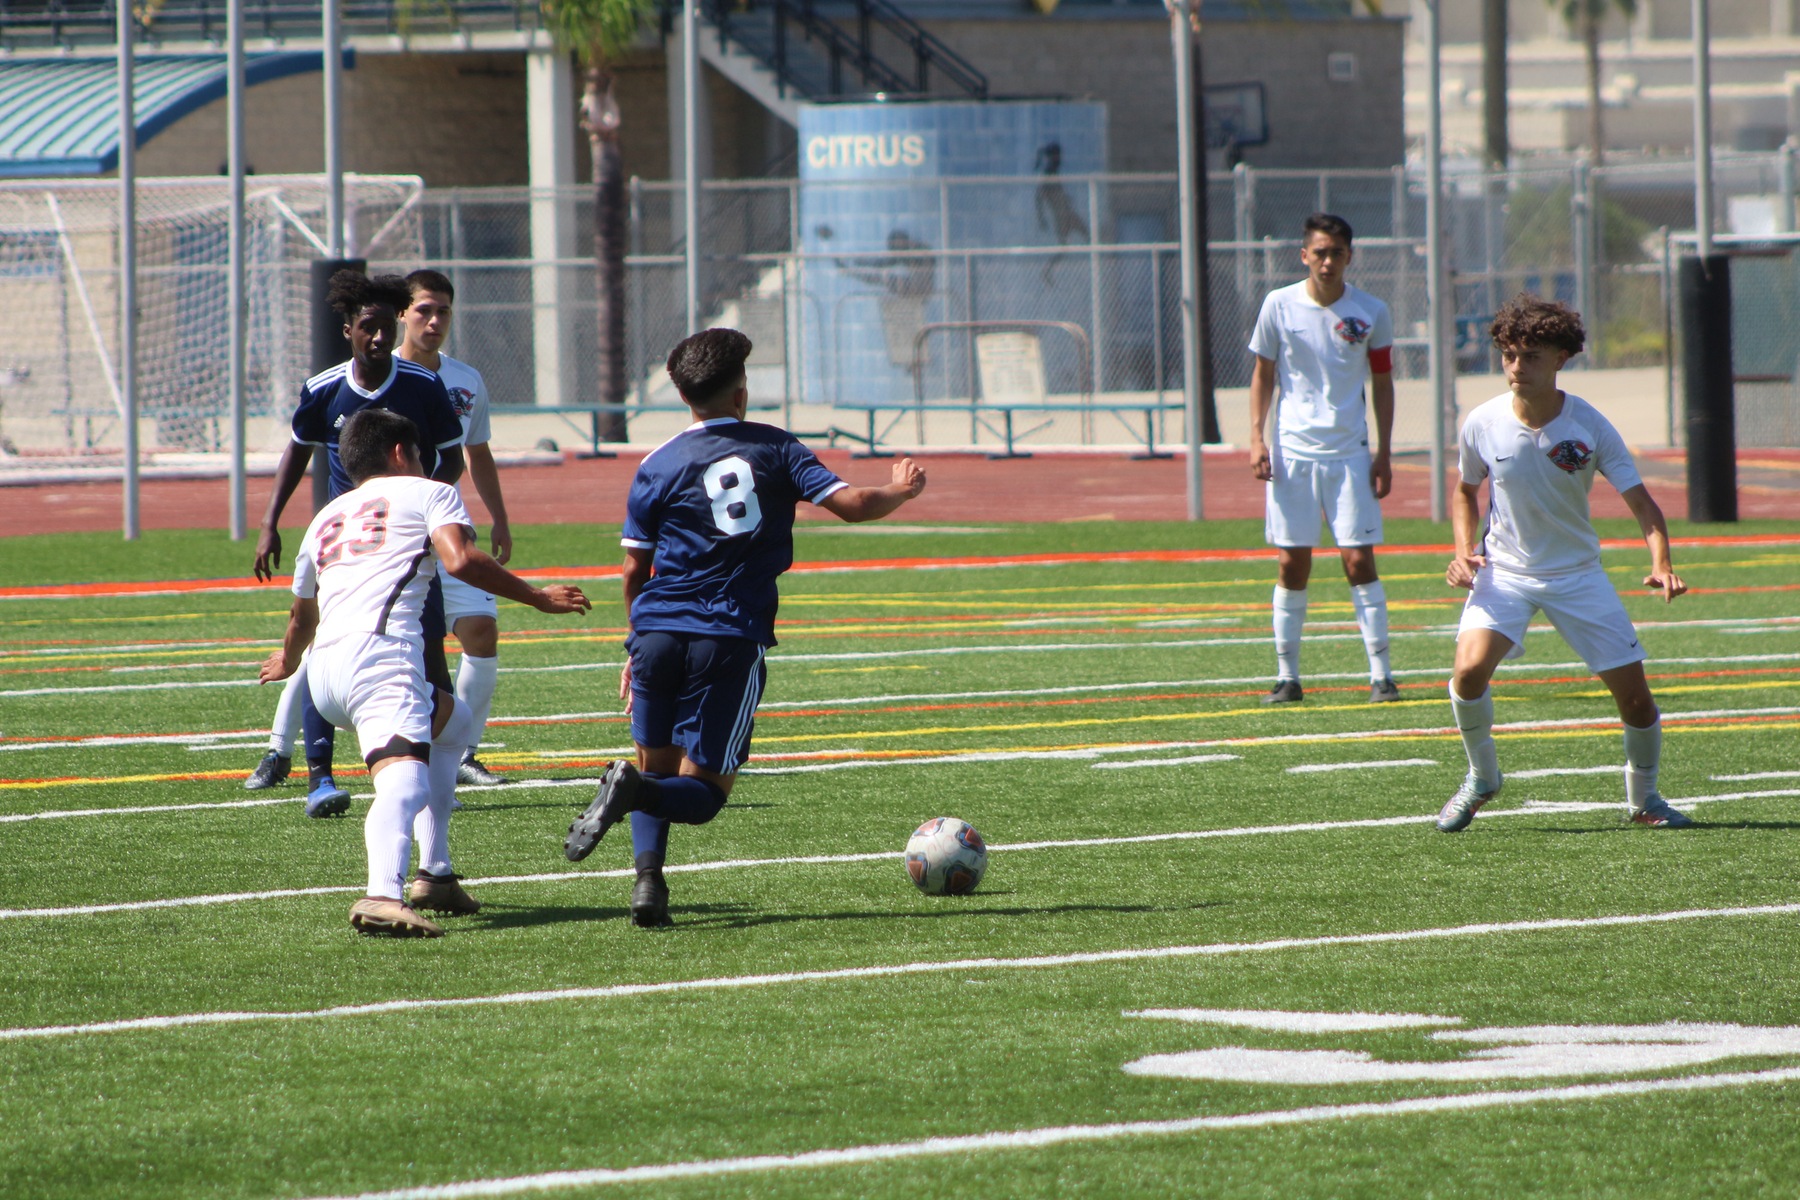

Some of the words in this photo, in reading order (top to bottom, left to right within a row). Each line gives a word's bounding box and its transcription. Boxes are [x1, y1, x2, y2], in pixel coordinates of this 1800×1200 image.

[807, 135, 925, 167] CITRUS
[702, 456, 763, 535] 8
[314, 496, 390, 574] 23
